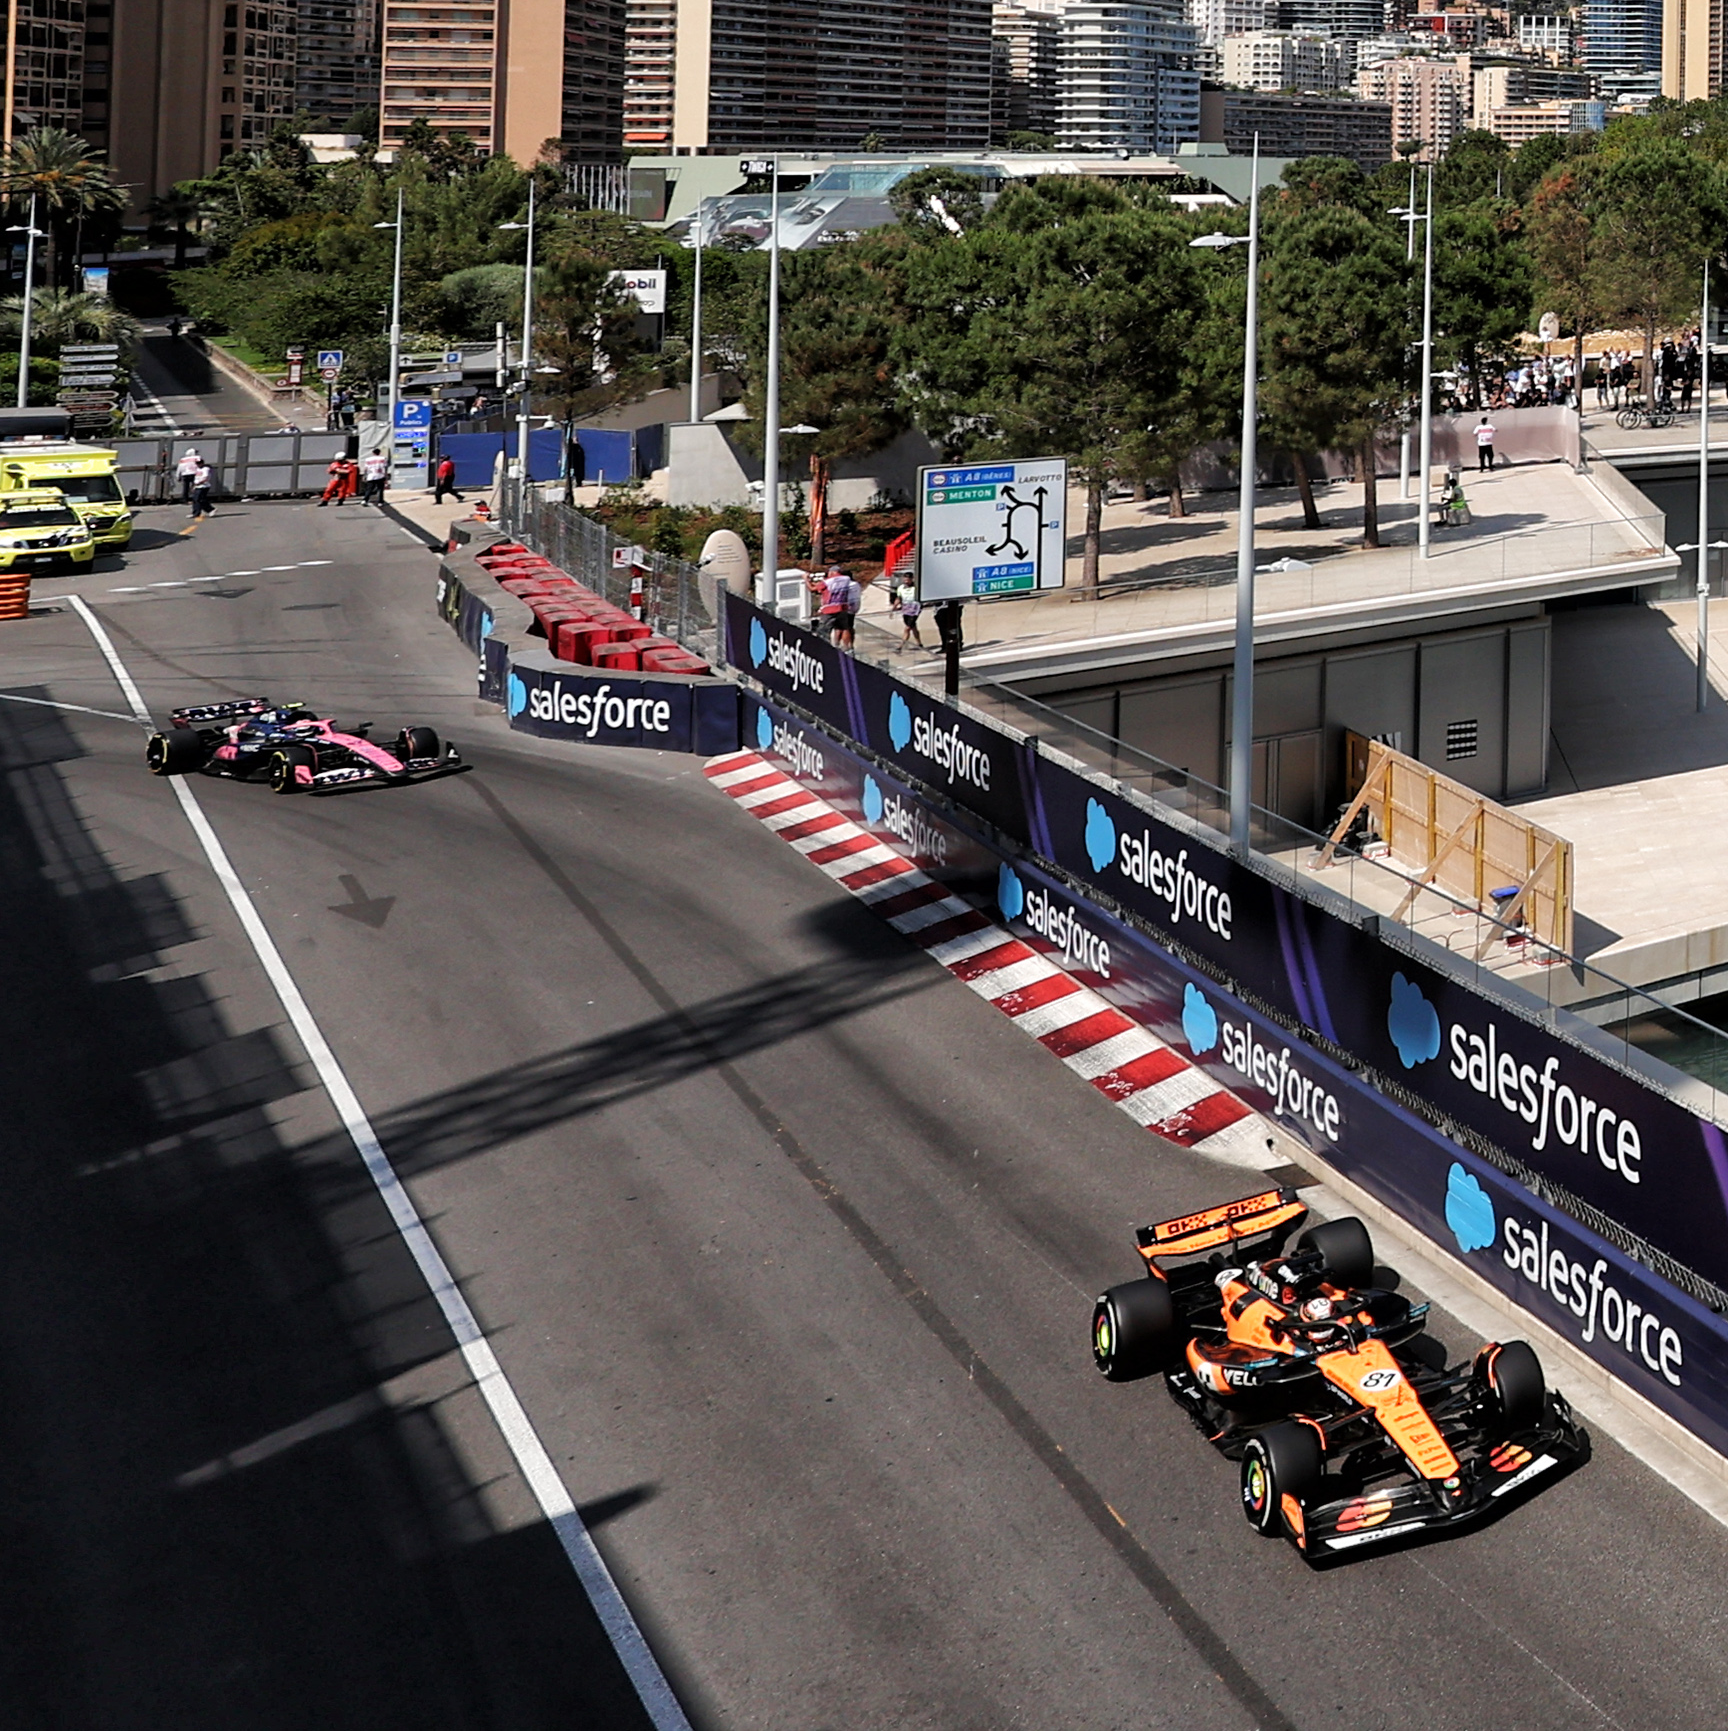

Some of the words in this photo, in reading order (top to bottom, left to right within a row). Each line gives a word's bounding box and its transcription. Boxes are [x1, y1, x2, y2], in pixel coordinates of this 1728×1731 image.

[619, 278, 656, 289] obil
[403, 403, 419, 418] P
[949, 489, 992, 500] MENTON
[1018, 474, 1062, 484] LARVOTTO
[933, 536, 987, 547] BEAUSOLEIL
[933, 545, 968, 555] CASINO
[990, 580, 1014, 589] NICE
[768, 631, 824, 694] salesforce
[529, 680, 670, 738] salesforce
[773, 721, 824, 781] salesforce
[913, 711, 990, 791] salesforce
[883, 795, 947, 867] salesforce
[1120, 829, 1232, 940] salesforce
[1026, 888, 1110, 979] salesforce
[1222, 1021, 1339, 1142] salesforce
[1450, 1023, 1641, 1184] salesforce
[1503, 1217, 1682, 1384] salesforce
[1363, 1373, 1396, 1388] 81
